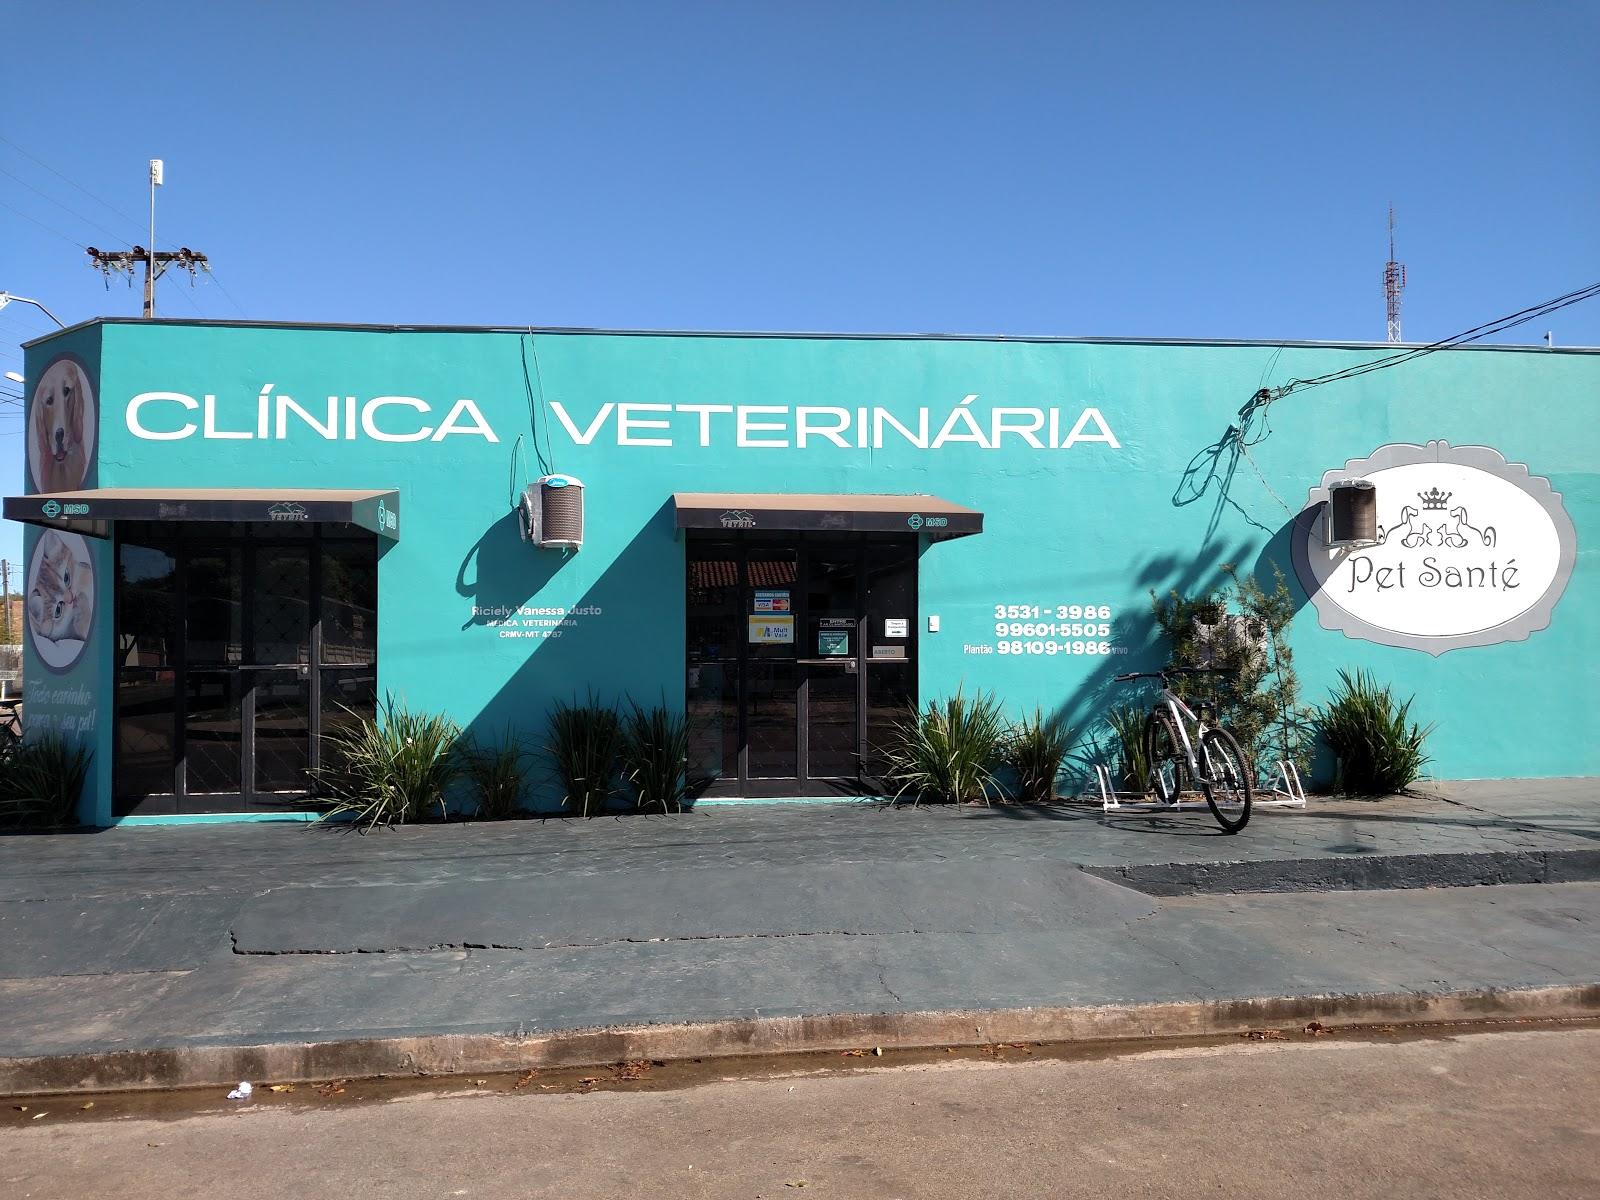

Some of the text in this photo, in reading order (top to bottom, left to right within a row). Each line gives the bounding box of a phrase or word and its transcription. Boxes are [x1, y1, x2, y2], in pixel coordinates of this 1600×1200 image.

[125, 383, 1121, 449] CLÍNICA VETERINÁRIA
[63, 503, 90, 515] MSD
[925, 517, 949, 528] MSD
[1347, 555, 1521, 593] Pet Santé
[471, 604, 602, 618] Riciely Vanessa Justo
[994, 604, 1040, 620] 3531
[1055, 605, 1111, 620] 3986
[499, 630, 563, 639] CRMV-MT 4787
[994, 622, 1111, 638] 99601-5505
[963, 643, 993, 654] Plantão
[997, 640, 1112, 656] 98109-1986
